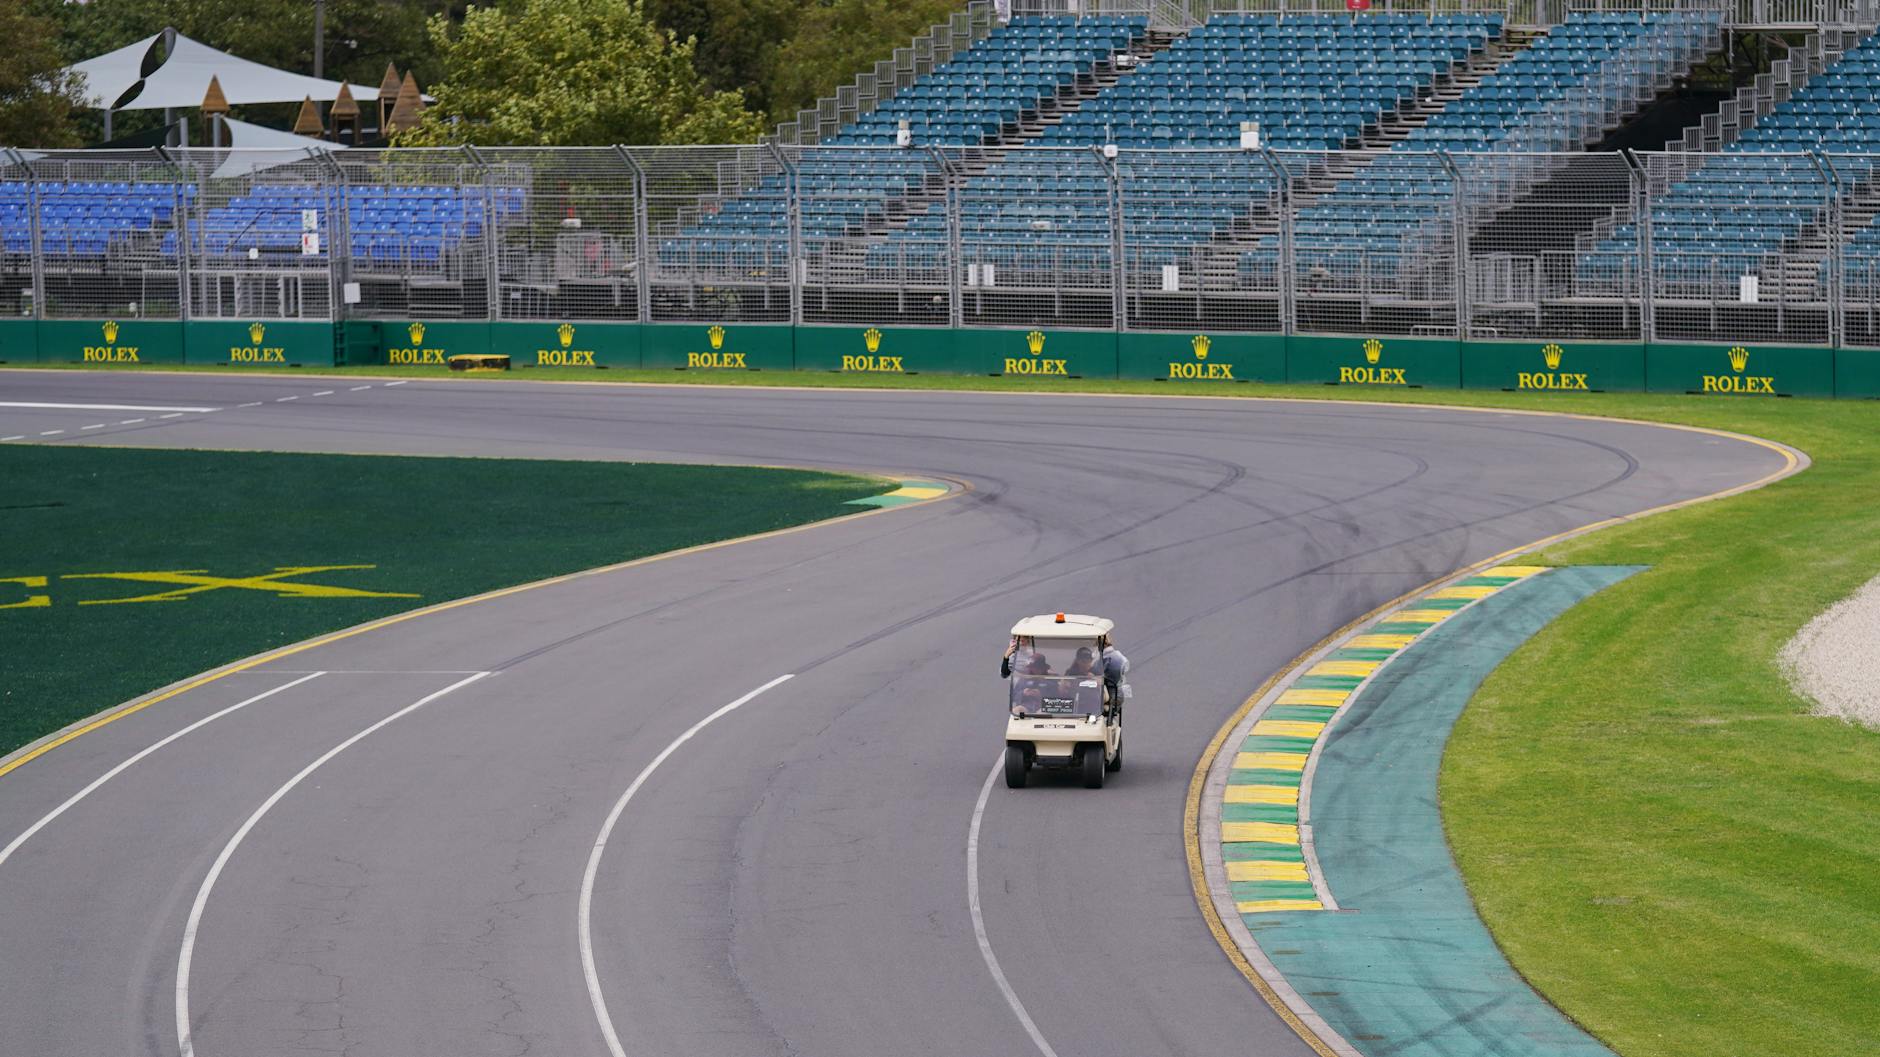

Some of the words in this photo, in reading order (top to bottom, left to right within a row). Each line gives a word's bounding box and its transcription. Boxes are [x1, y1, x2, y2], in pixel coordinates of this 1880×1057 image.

[83, 348, 139, 362] ROLEX
[231, 348, 285, 362] ROLEX
[389, 349, 445, 364] ROLEX
[538, 351, 595, 366] ROLEX
[688, 353, 746, 369] ROLEX
[842, 356, 904, 373] ROLEX
[1004, 358, 1067, 375] ROLEX
[1169, 362, 1233, 380] ROLEX
[1340, 367, 1406, 385] ROLEX
[1519, 372, 1588, 390] ROLEX
[1703, 376, 1774, 394] ROLEX
